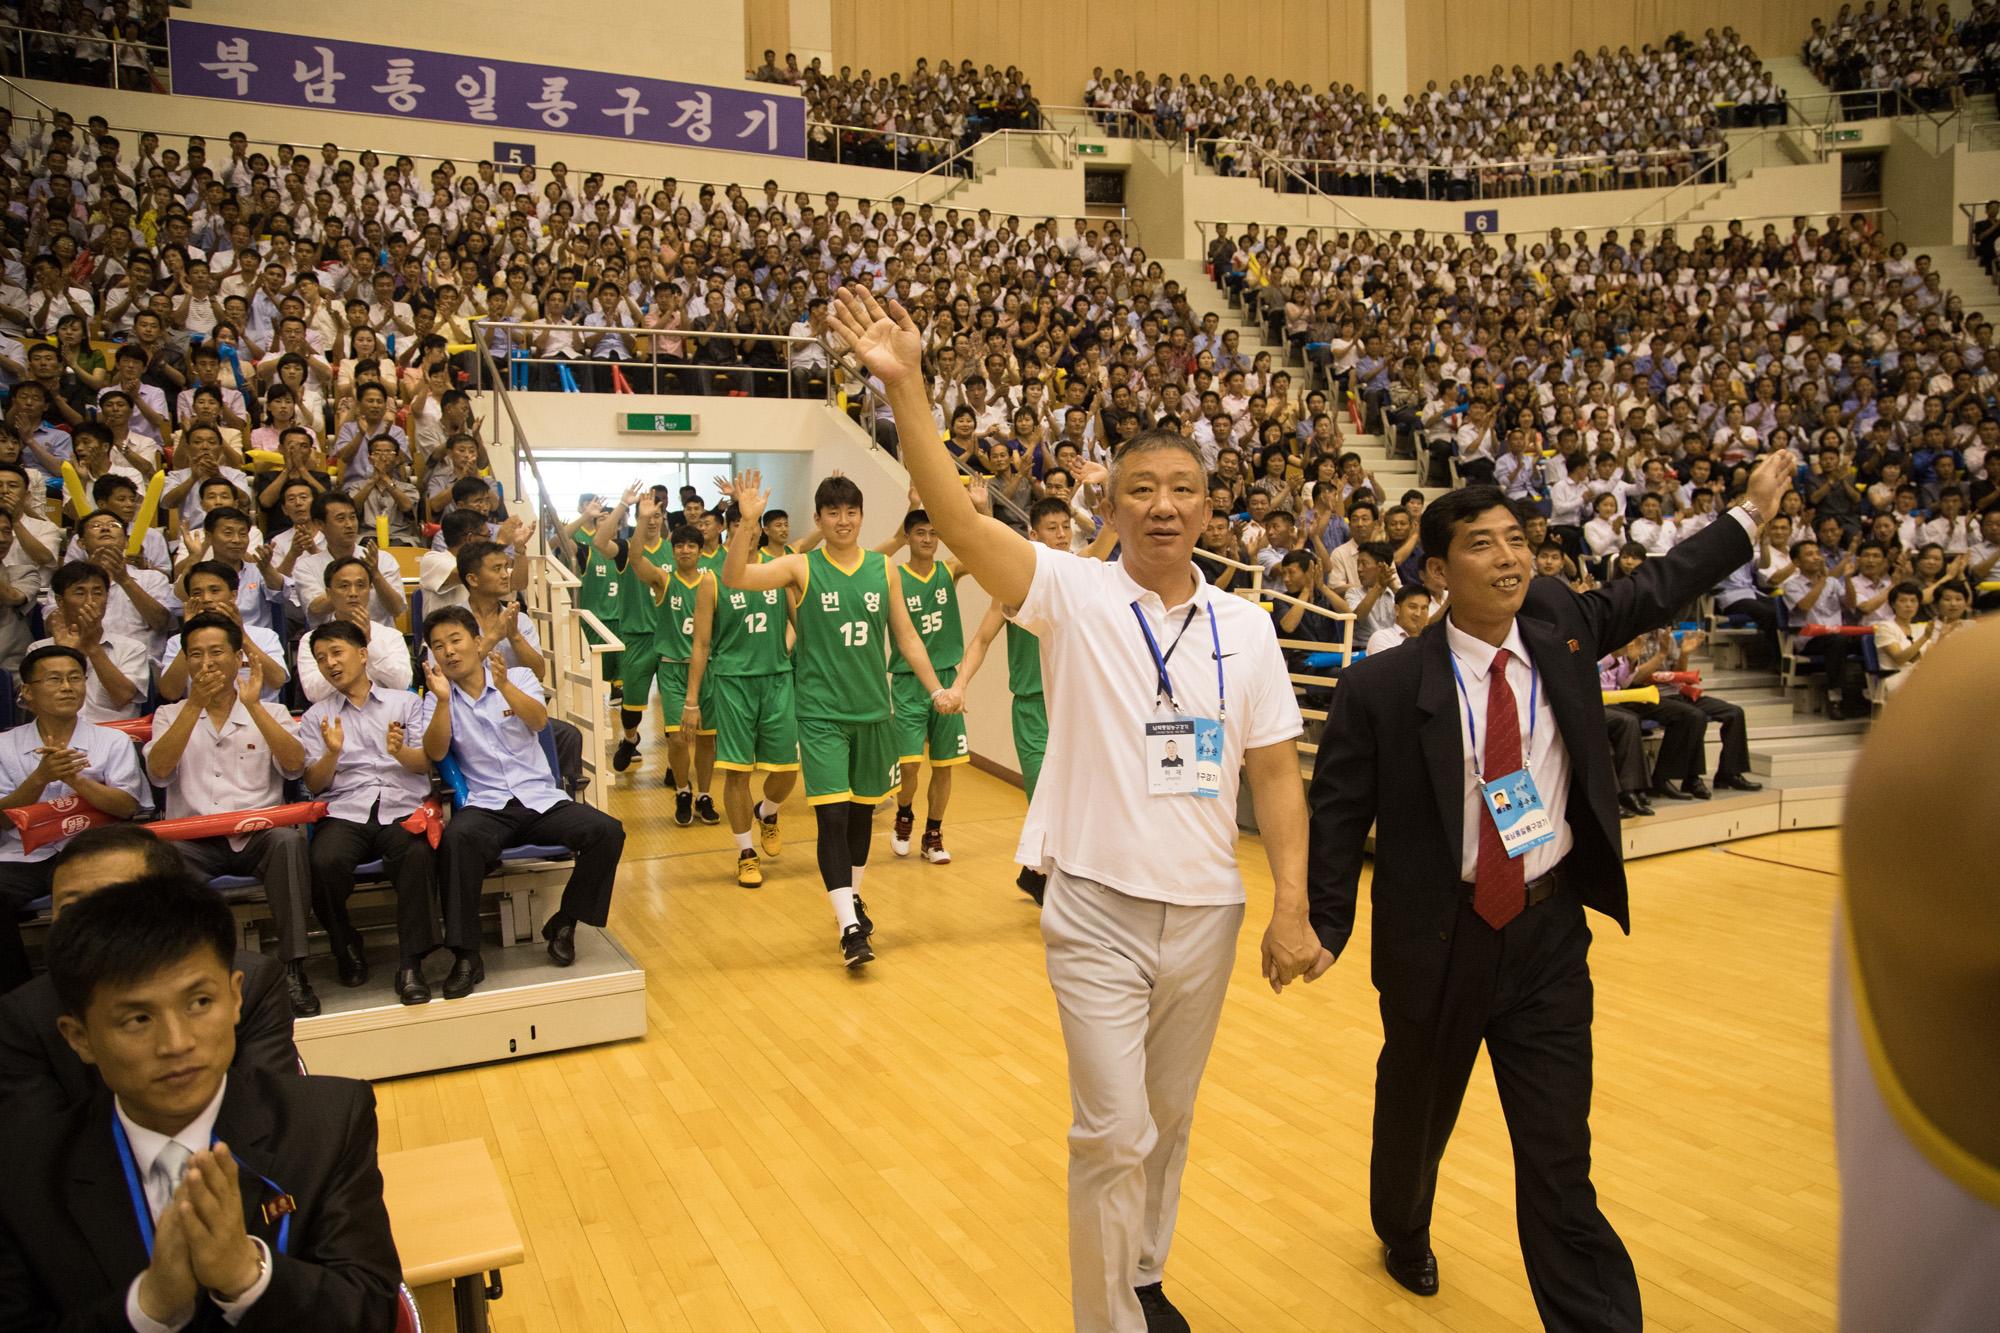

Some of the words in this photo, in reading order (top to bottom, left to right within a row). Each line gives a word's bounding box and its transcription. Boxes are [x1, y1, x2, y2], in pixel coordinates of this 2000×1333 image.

[199, 37, 778, 151] 북남통일롱구경기
[509, 148, 522, 164] 5
[1475, 214, 1488, 231] 6
[595, 565, 607, 577] 번
[608, 582, 619, 597] 3
[906, 595, 923, 612] 번
[935, 587, 948, 605] 영
[670, 595, 682, 611] 번
[729, 592, 747, 610] 번
[820, 591, 840, 612] 번
[864, 591, 881, 613] 영
[682, 617, 694, 635] 6
[744, 612, 768, 634] 12
[920, 610, 943, 635] 35
[839, 620, 869, 647] 13
[888, 761, 902, 787] 13
